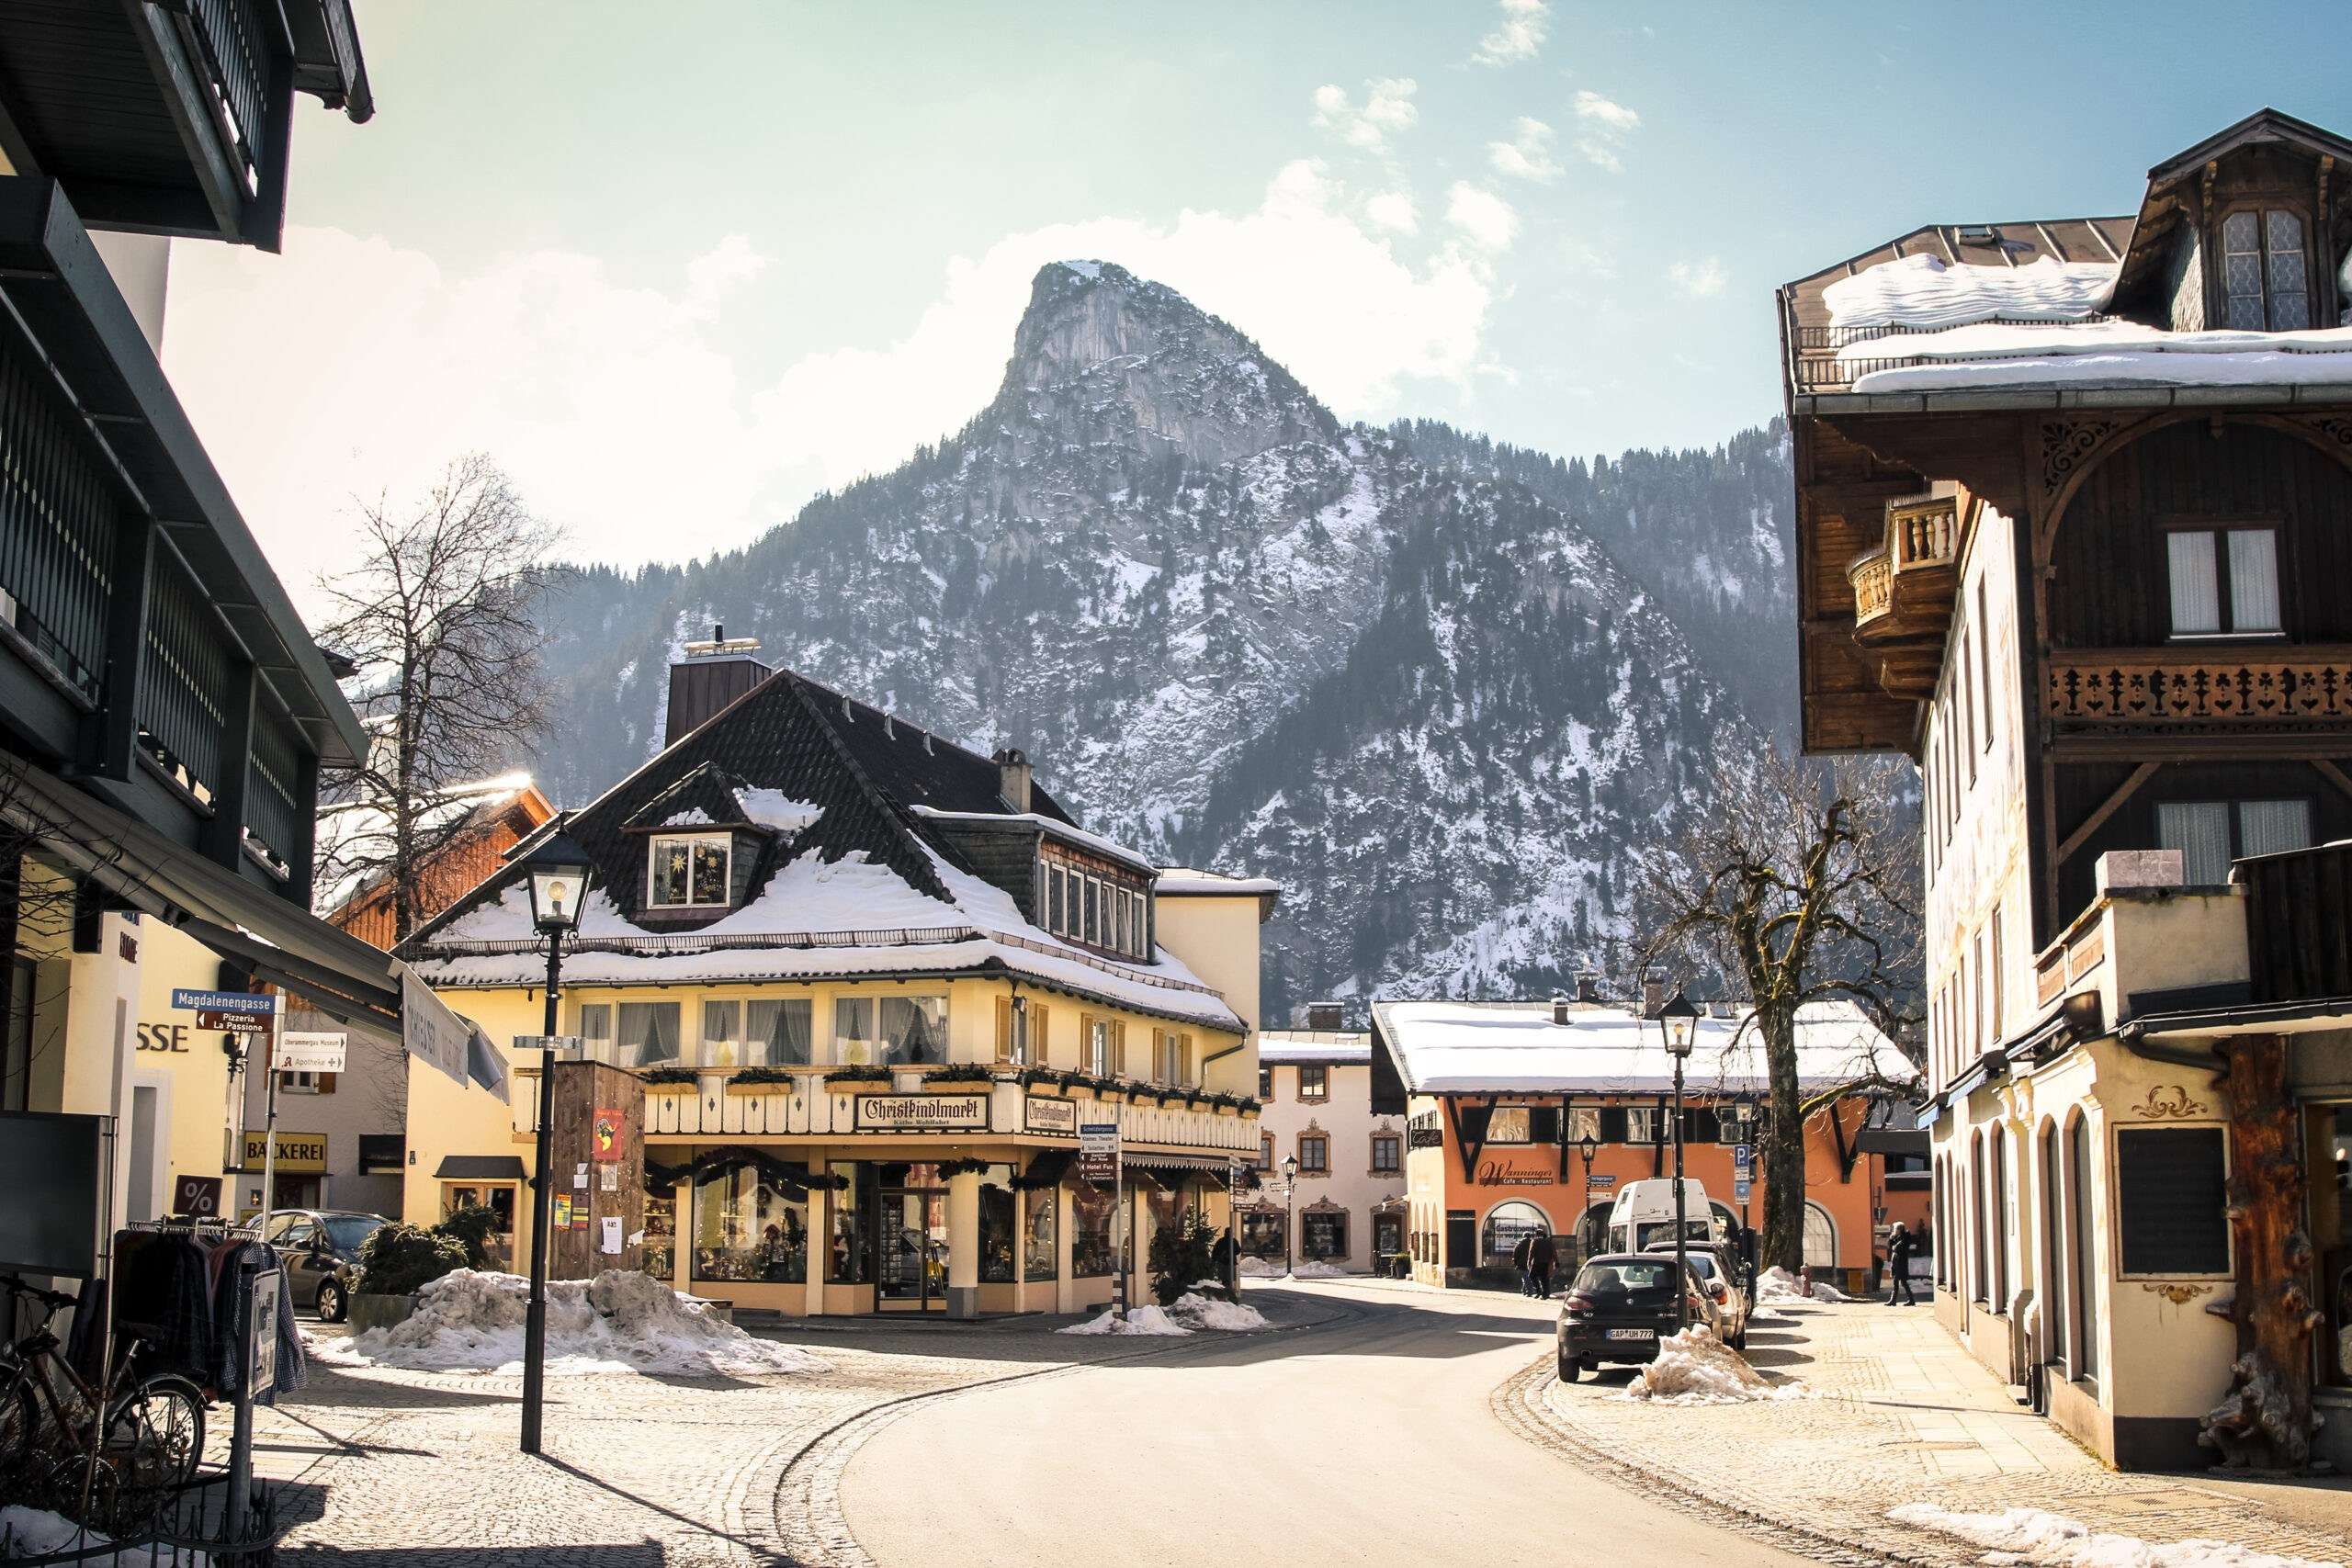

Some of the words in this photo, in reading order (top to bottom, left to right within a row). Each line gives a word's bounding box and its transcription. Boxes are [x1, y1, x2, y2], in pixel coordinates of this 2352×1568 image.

[178, 992, 270, 1010] Magdalenengasse
[222, 1012, 255, 1022] Pizzeria
[213, 1021, 224, 1030] La
[226, 1022, 264, 1032] Passione
[285, 1038, 319, 1047] Oberammergau
[295, 1057, 325, 1066] Apotheke
[865, 1099, 978, 1121] Christkindlmarkt
[1479, 1159, 1552, 1188] Wanninger
